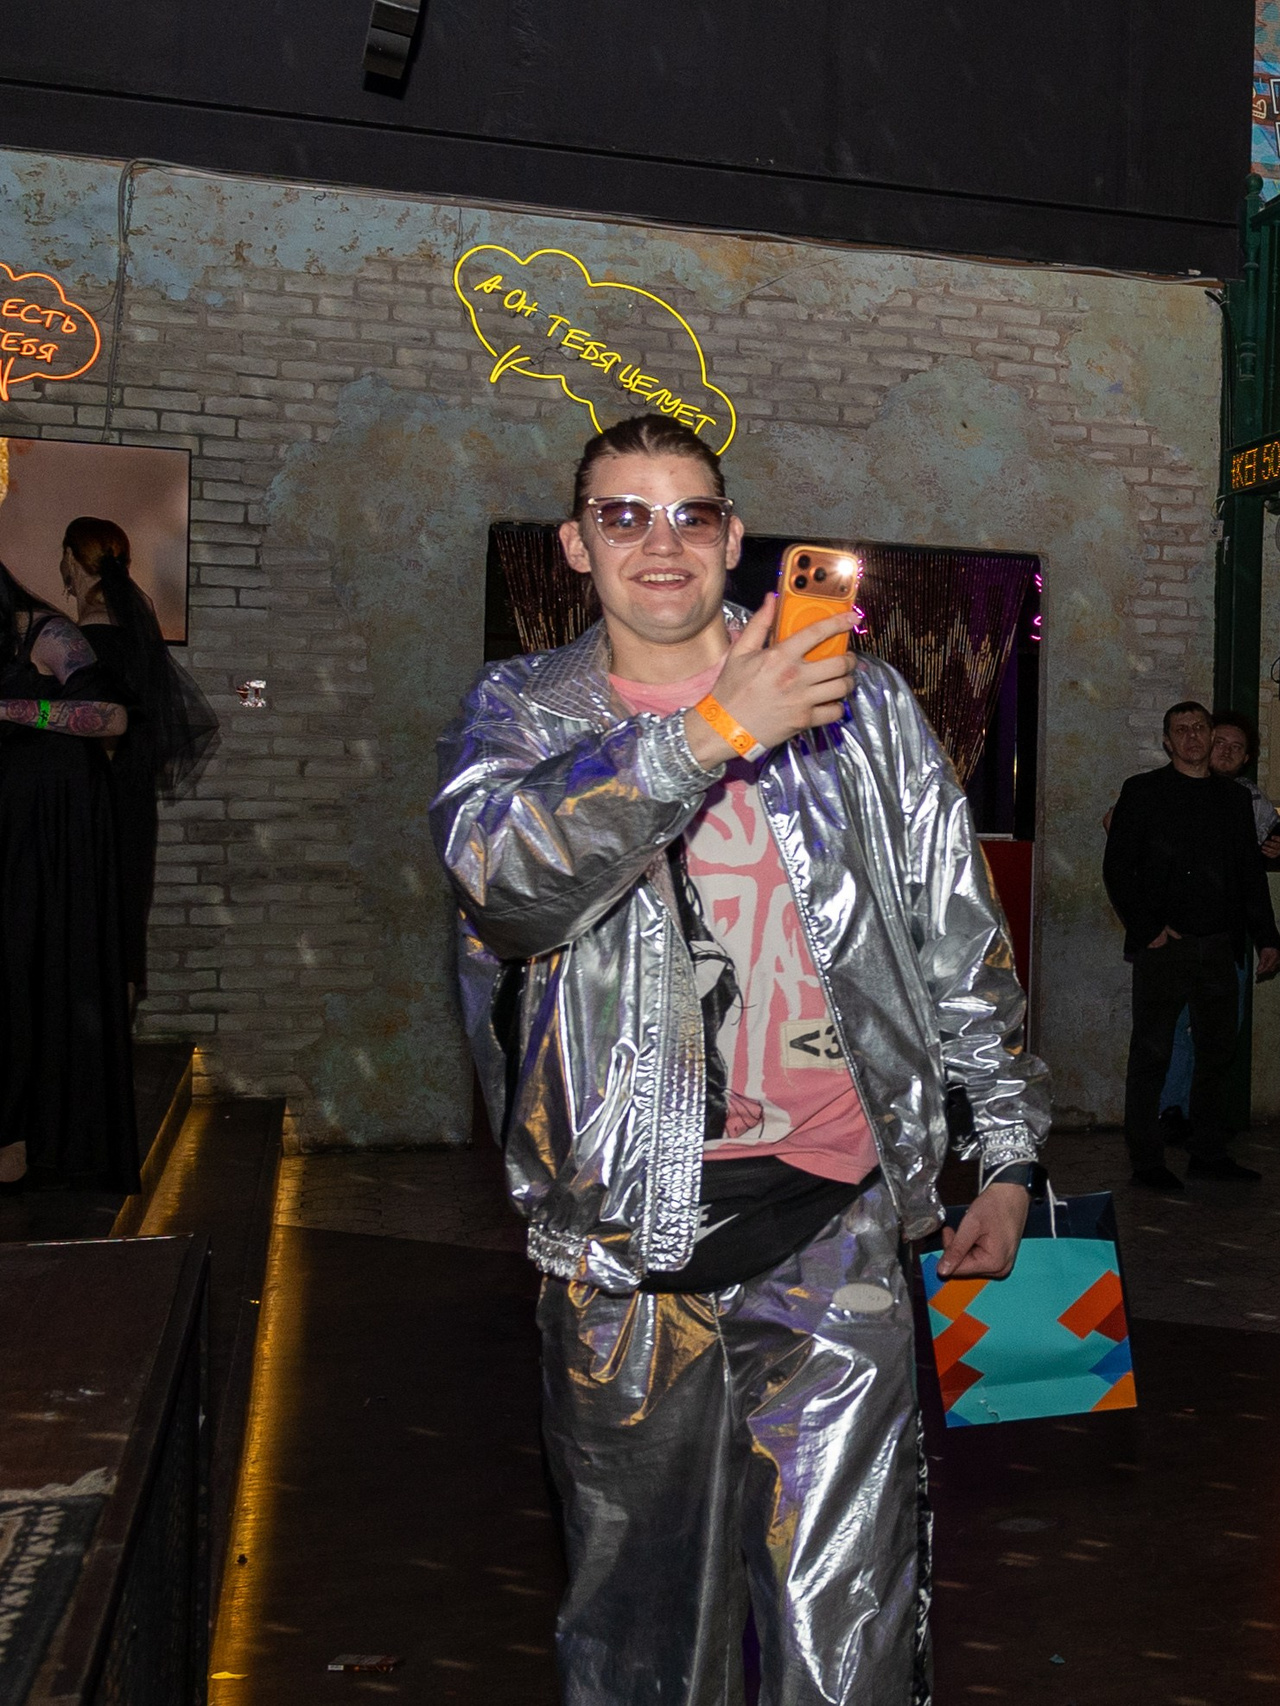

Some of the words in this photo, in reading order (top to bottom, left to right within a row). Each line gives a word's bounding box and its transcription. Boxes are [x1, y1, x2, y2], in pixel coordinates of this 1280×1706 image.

[0, 327, 59, 364] ЕБЯ
[474, 274, 502, 294] А
[503, 289, 539, 318] ОН
[547, 313, 622, 374] ТЕБЯ
[618, 363, 717, 435] ЦЕЛУЕТ
